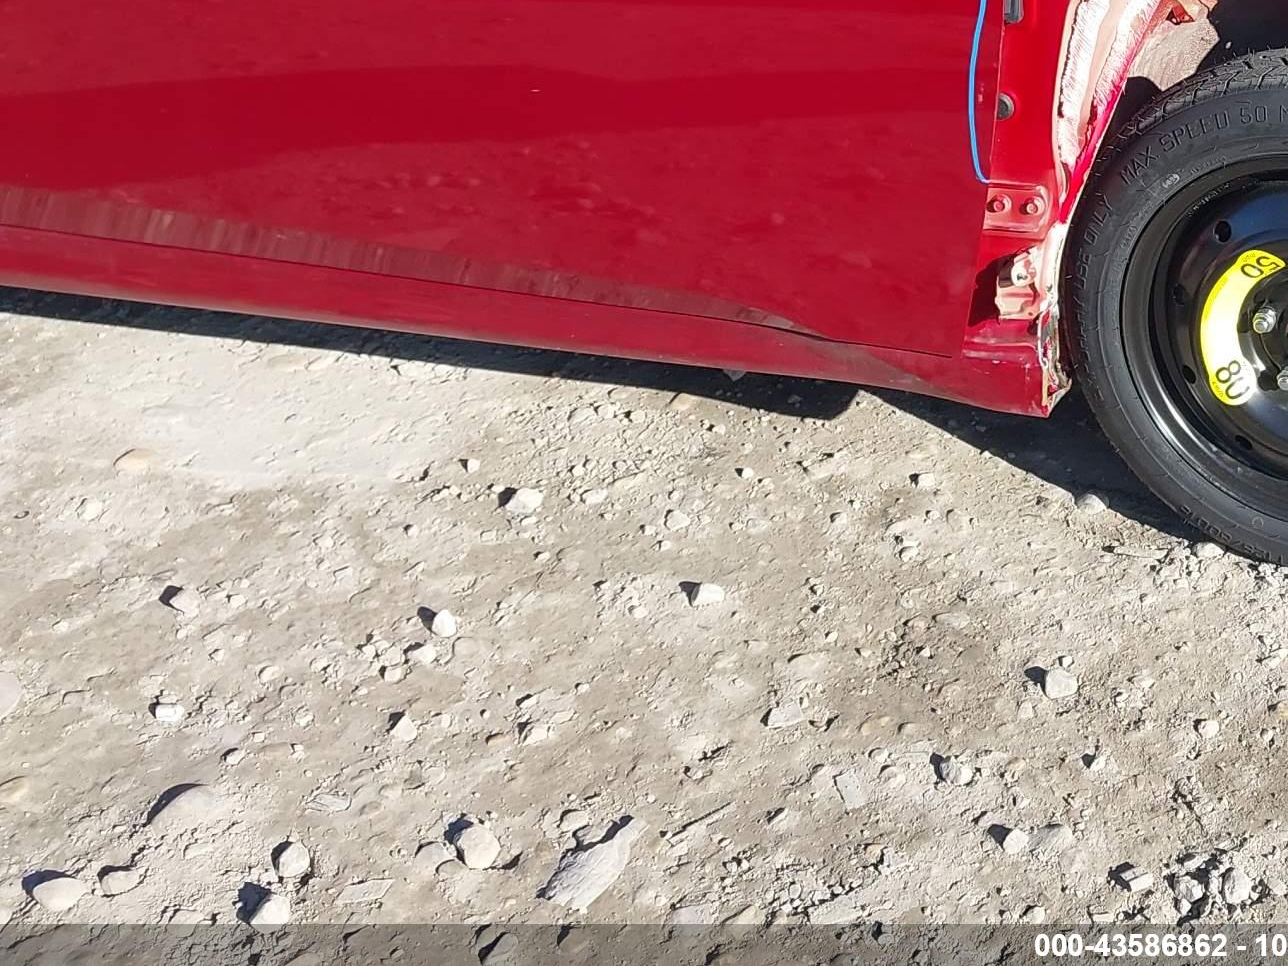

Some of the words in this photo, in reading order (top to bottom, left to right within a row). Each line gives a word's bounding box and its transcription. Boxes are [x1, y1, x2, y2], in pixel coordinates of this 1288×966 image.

[1119, 145, 1161, 185] MAX.
[1159, 110, 1230, 152] SPEED
[1239, 105, 1268, 124] 50
[1084, 192, 1114, 247] ONLY
[1240, 256, 1281, 279] 50
[1215, 360, 1251, 400] 80
